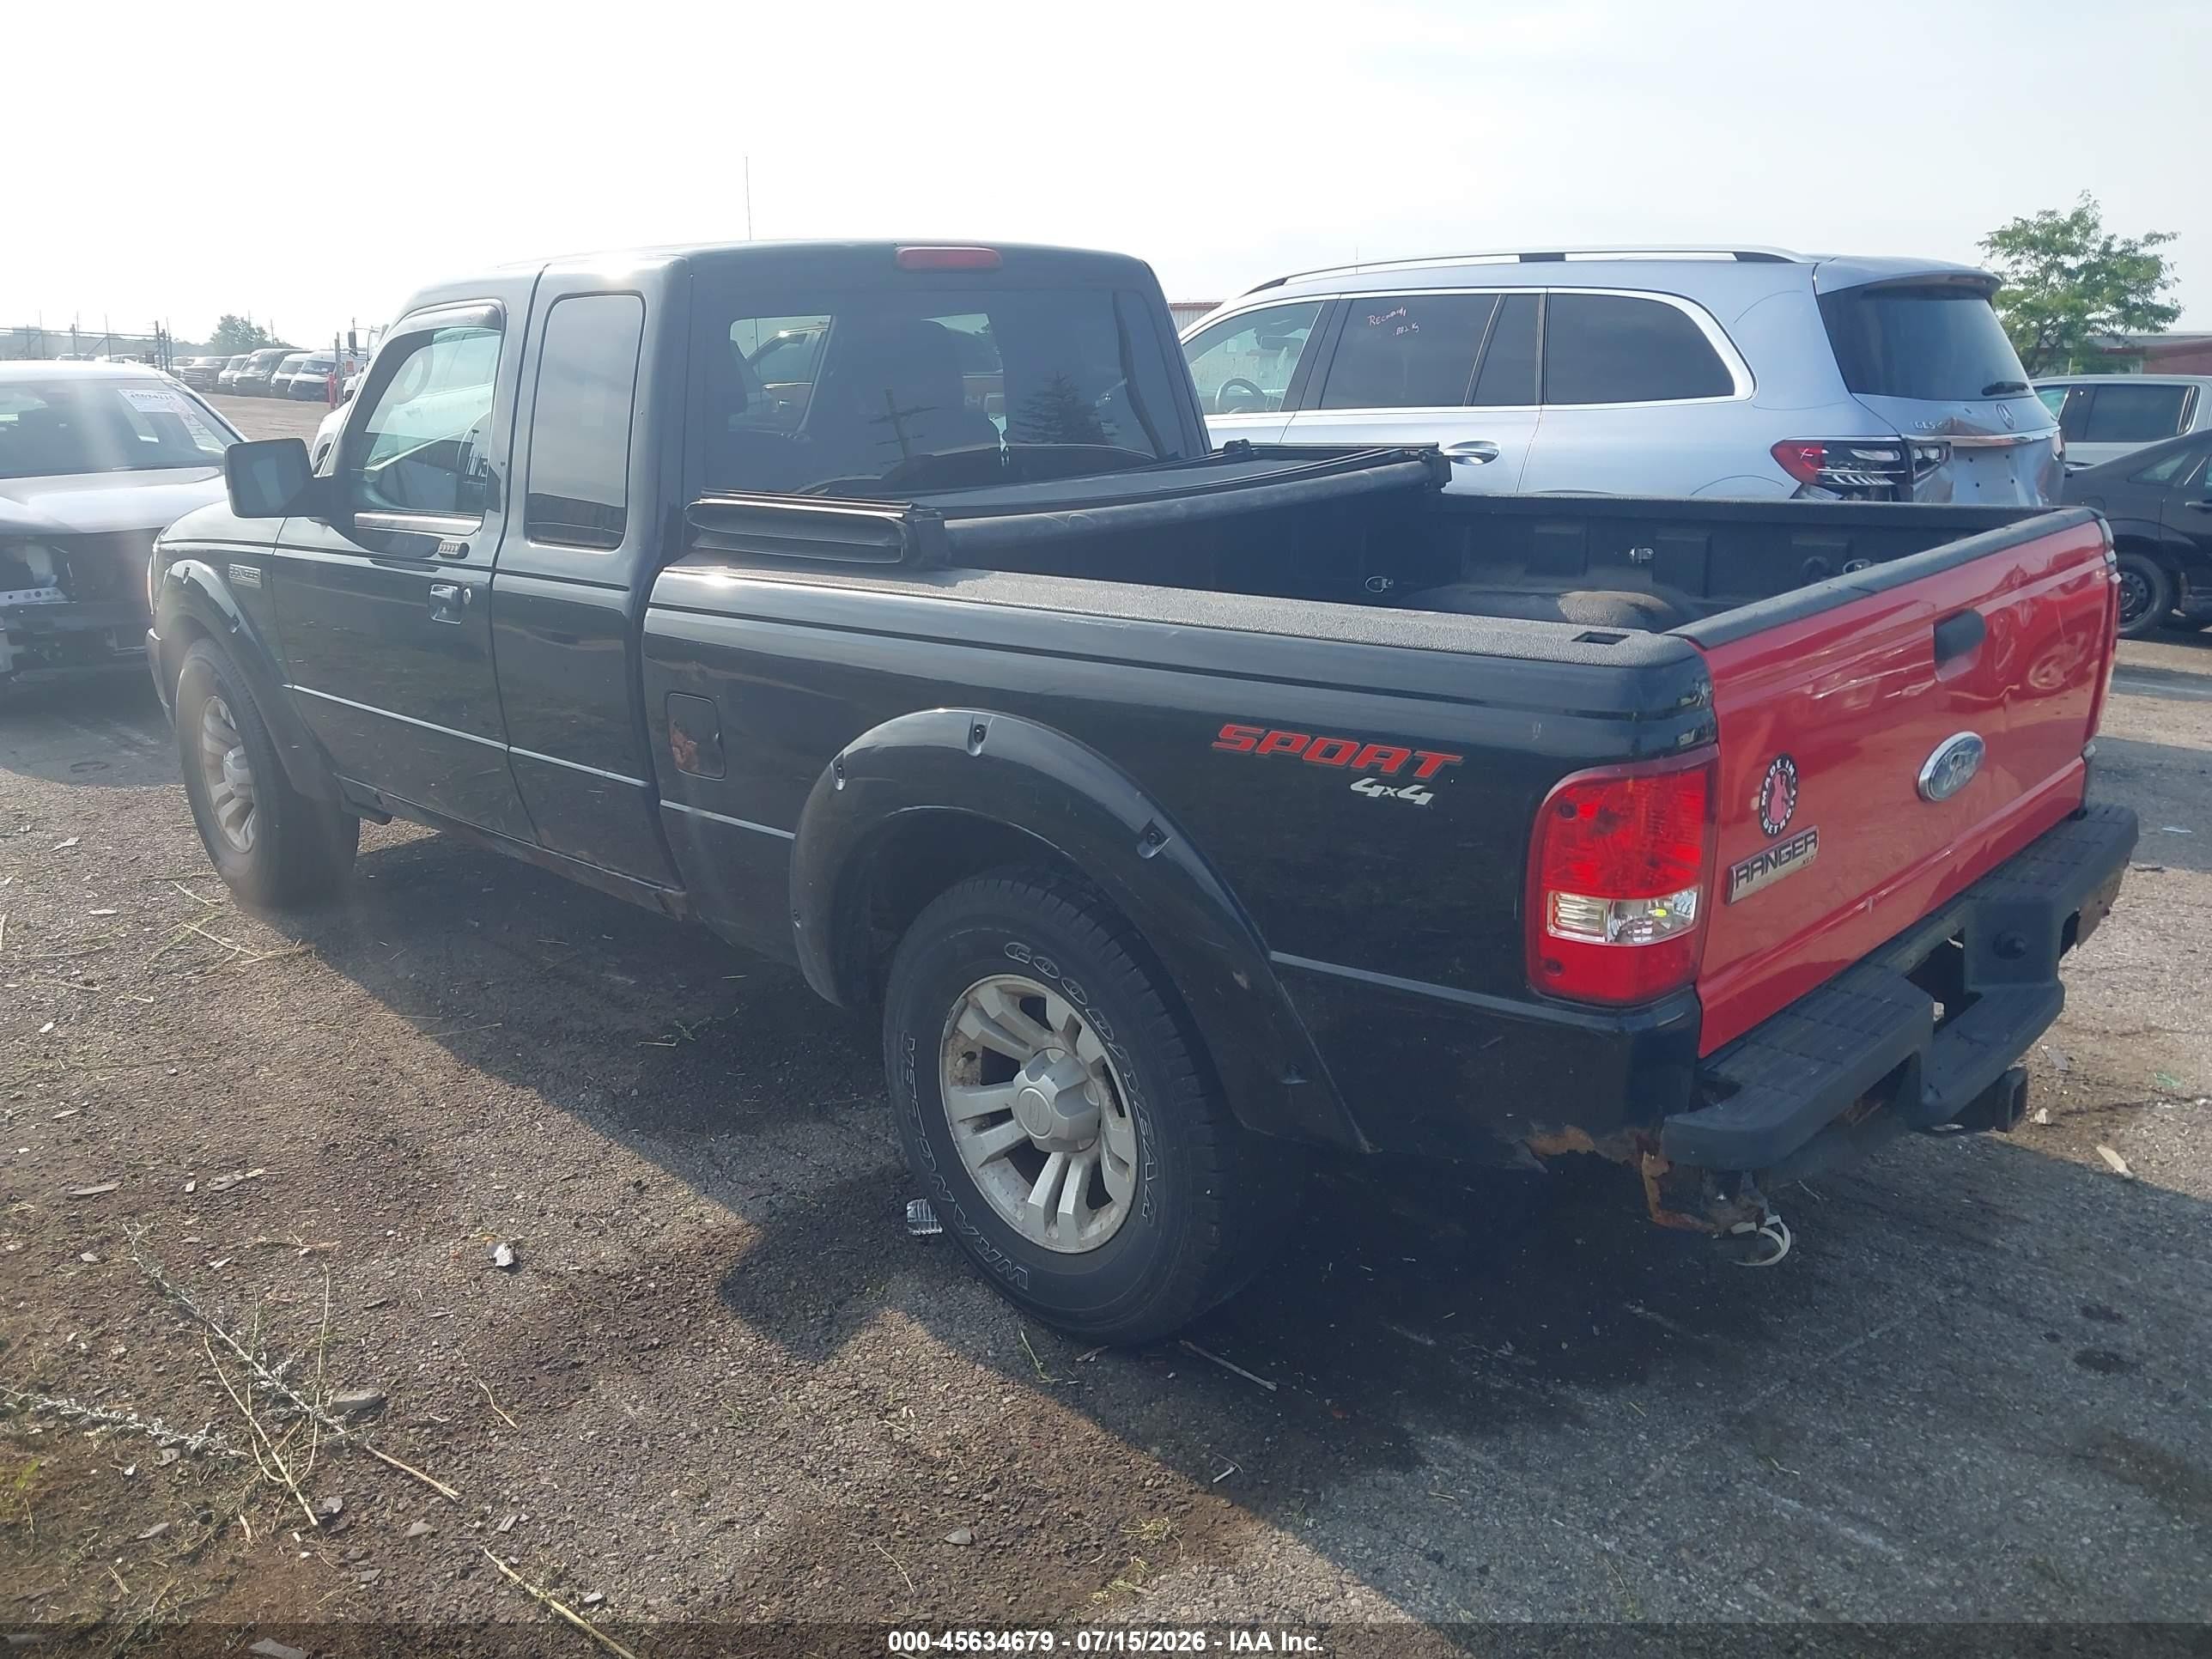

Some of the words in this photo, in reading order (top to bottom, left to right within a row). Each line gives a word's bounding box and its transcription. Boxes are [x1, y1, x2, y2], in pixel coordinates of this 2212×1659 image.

[1212, 724, 1464, 781] SPORT
[1350, 776, 1434, 806] 4x4
[1735, 830, 1818, 890] RANGER
